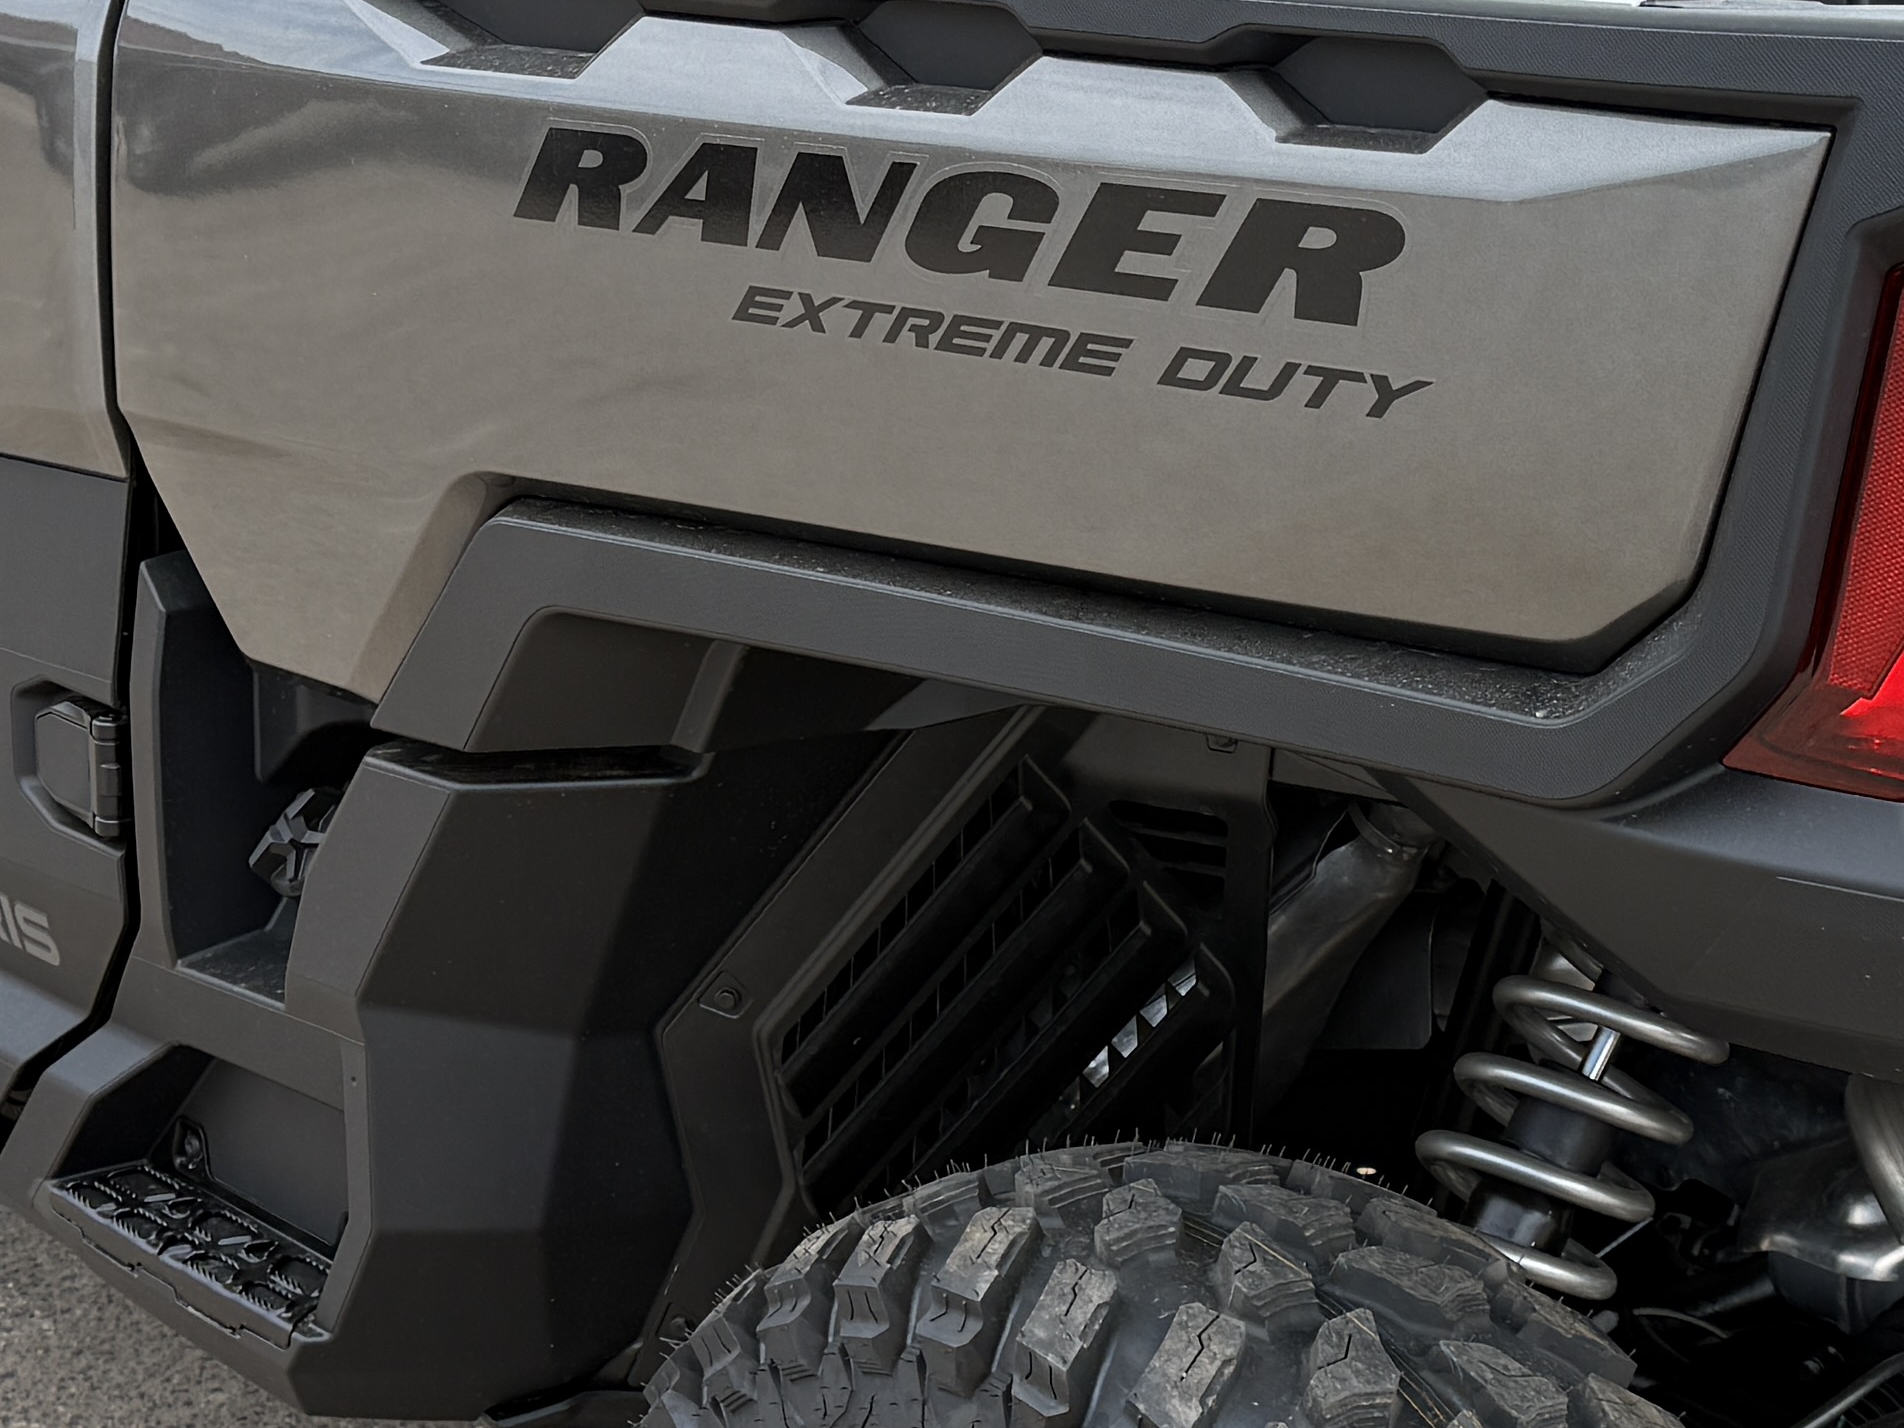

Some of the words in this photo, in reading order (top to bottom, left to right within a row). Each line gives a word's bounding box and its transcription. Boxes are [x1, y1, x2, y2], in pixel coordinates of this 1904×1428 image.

[512, 126, 1408, 328] RANGER
[730, 284, 1136, 378] EXTREME
[1156, 344, 1434, 420] DUTY
